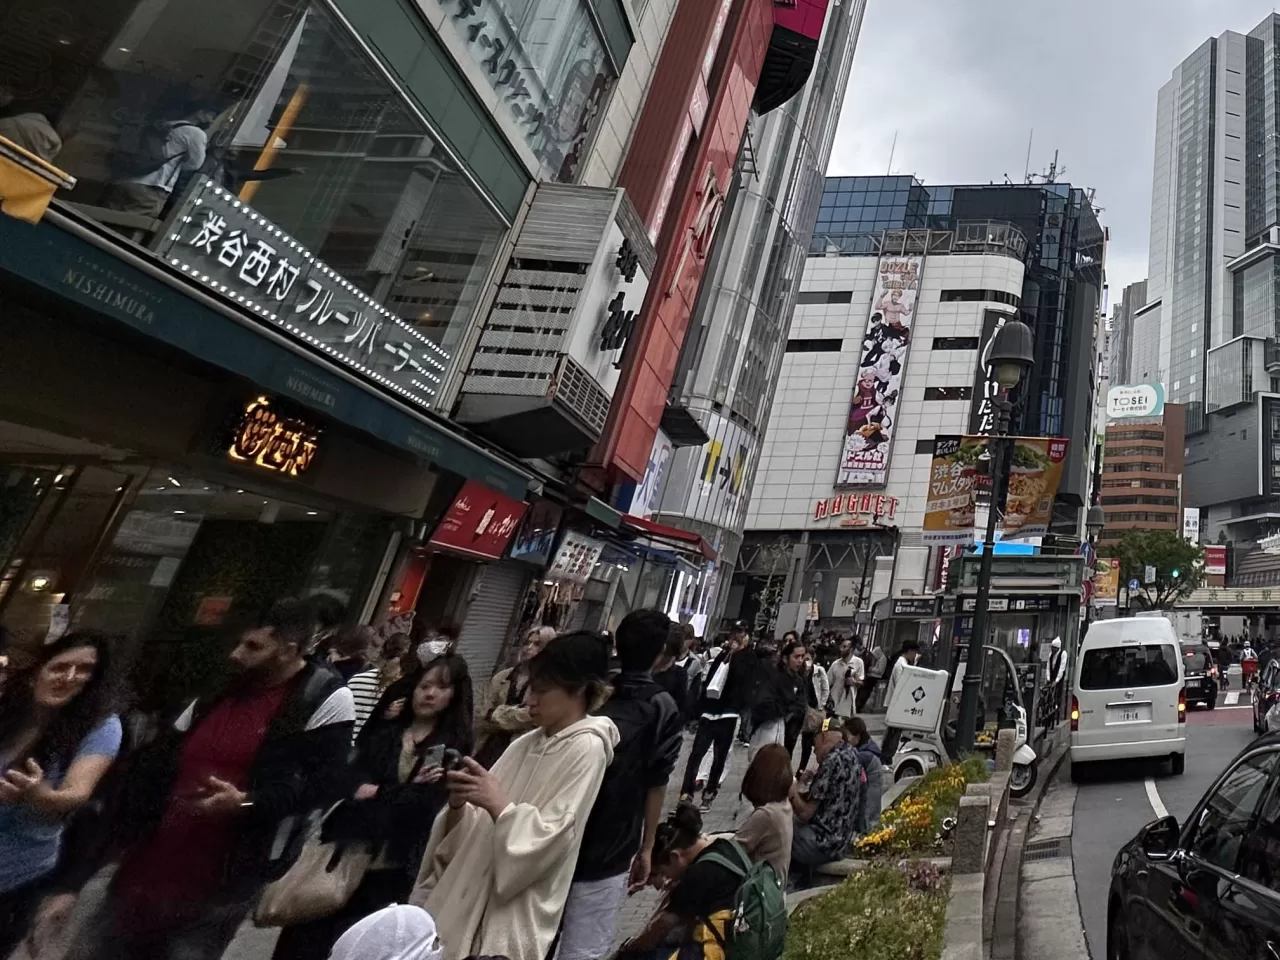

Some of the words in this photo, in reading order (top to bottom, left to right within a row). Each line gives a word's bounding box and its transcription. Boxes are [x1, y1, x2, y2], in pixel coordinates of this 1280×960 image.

[62, 268, 156, 325] NISHIMURA
[190, 210, 301, 301] 渋谷西村
[295, 278, 420, 372] フルーツパーラー
[1113, 396, 1148, 406] TOSEI
[934, 461, 964, 480] 渋谷
[814, 494, 900, 521] MAGNET
